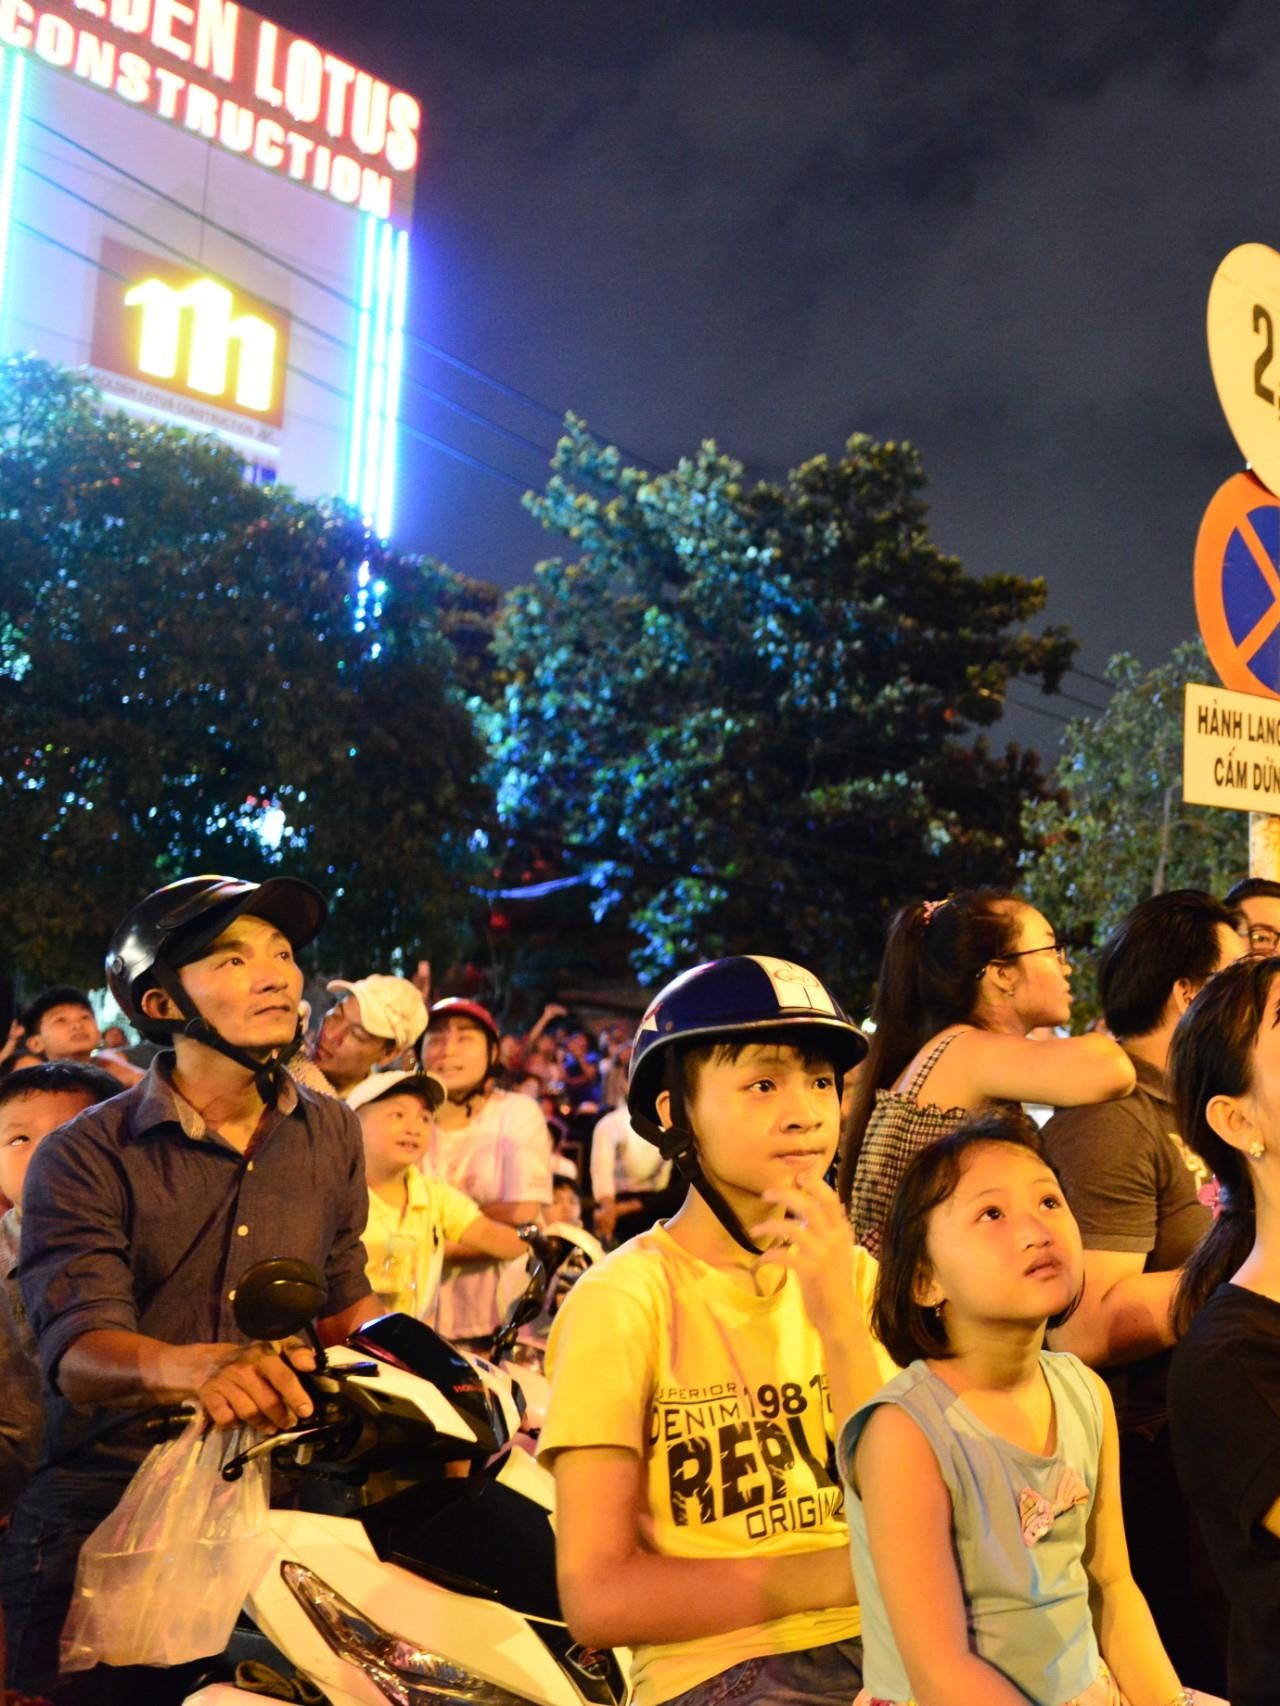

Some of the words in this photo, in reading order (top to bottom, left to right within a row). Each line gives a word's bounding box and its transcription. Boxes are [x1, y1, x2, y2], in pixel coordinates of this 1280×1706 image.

[254, 19, 421, 171] LOTUS
[1197, 698, 1242, 739] HÀNH
[1214, 746, 1247, 788] CẤM
